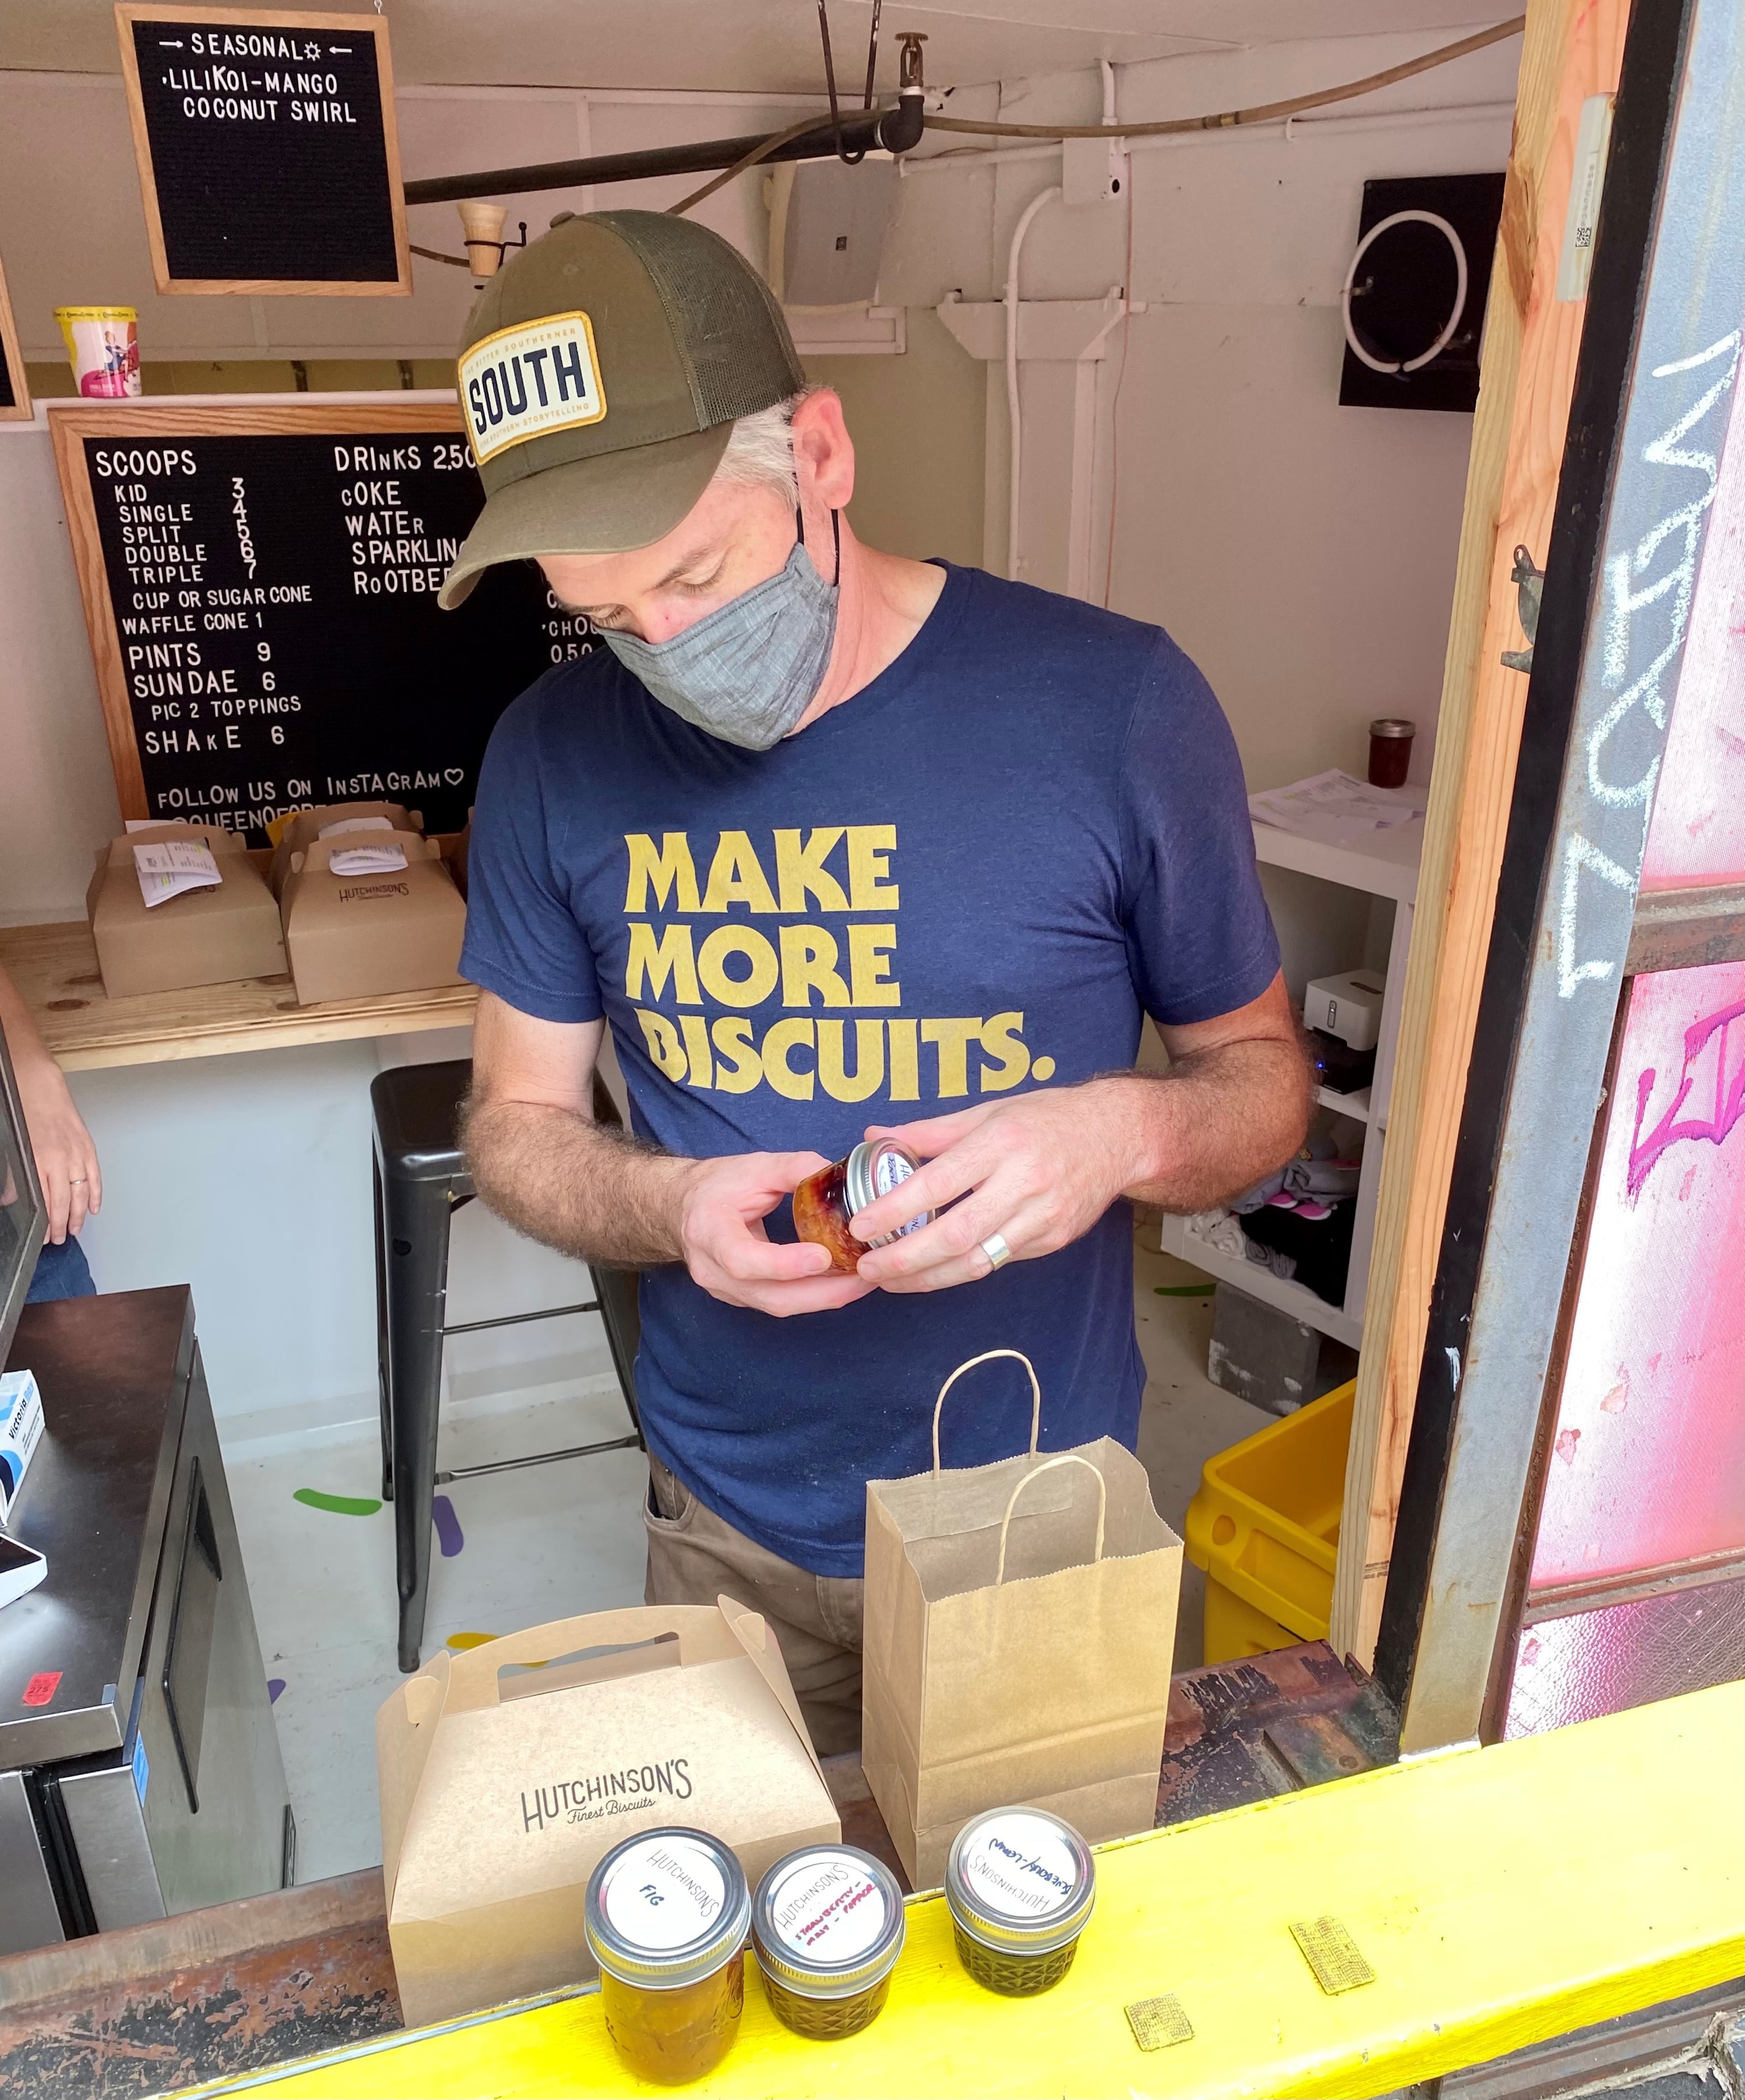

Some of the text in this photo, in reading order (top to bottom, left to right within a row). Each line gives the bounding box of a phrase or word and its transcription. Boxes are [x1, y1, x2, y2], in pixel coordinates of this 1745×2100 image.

[191, 33, 304, 60] SEASONAL
[169, 65, 337, 95] LILIKOI-MANGO
[183, 97, 357, 123] COCONUT SWIRL
[476, 349, 499, 367] BITTER
[504, 328, 576, 353] SOUTHERNER
[469, 342, 586, 435] SOUTH
[490, 422, 520, 441] SOUTHERN
[523, 403, 589, 426] STORYTELLING
[96, 450, 196, 476] SCOOPS
[334, 446, 421, 471] DRINKS
[115, 477, 245, 503] KID 3
[120, 499, 247, 523] SINGLE 4
[345, 511, 424, 536] WATER
[123, 519, 250, 544] SPLIT 5
[125, 539, 254, 564] DOUBLE 6
[352, 538, 465, 565] SPARKLIN
[128, 559, 257, 584] TRIPLE 7
[133, 585, 312, 610] CUP OR SUGAR CONE
[122, 612, 262, 635] WAFFLE CONE 1
[129, 642, 271, 670] PINTS 9
[134, 670, 275, 698] SUNDAE 6
[151, 695, 301, 721] PIC 2 TOPPINGS
[145, 725, 284, 754] SHAKE 6
[158, 771, 440, 808] FOLLOW US ON INSTAGRAM
[623, 824, 900, 913] MAKE
[625, 923, 901, 1008] MORE
[633, 1008, 1056, 1102] BISCUITS.
[9, 1397, 27, 1440] Victoria
[521, 1758, 693, 1833] HUTCHINSON'S
[567, 1796, 656, 1824] Finest Biscuits
[639, 1885, 665, 1906] FIG
[646, 1849, 720, 1917] HUTCHINSON'S
[773, 1865, 849, 1930] HUTCHINSON'S
